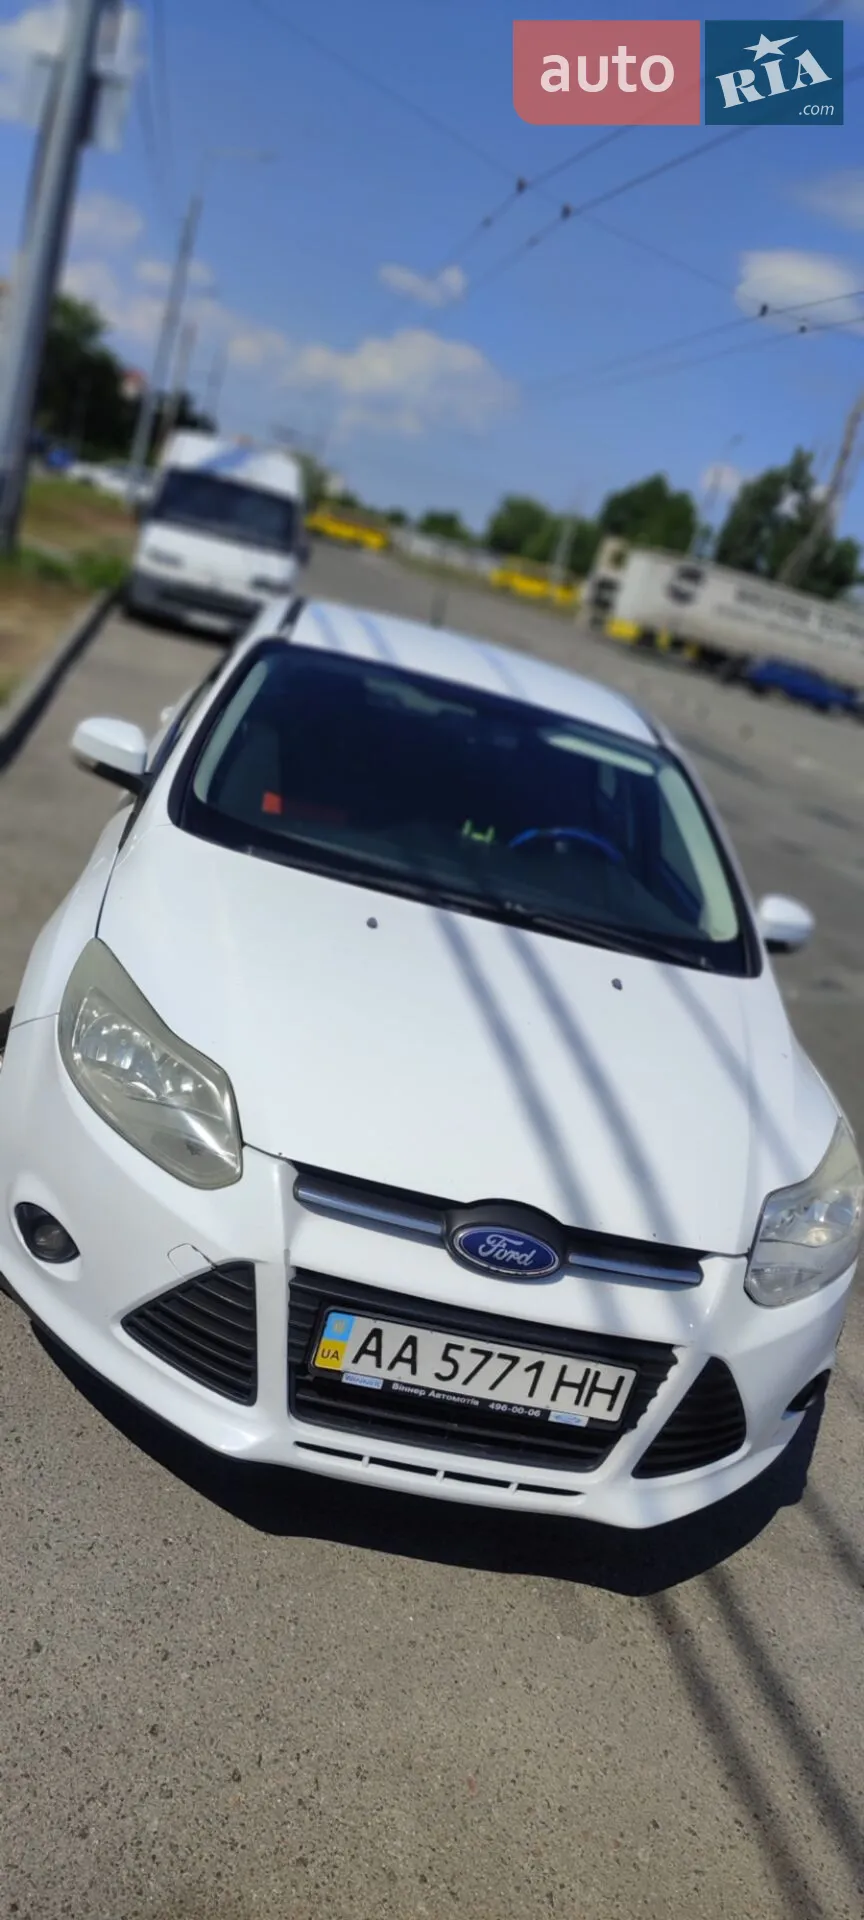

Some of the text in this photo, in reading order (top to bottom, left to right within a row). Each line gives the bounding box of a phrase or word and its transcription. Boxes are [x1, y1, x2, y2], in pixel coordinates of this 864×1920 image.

[478, 1234, 536, 1267] Ford
[321, 1349, 340, 1361] UA
[352, 1327, 625, 1412] AA 5771 HH
